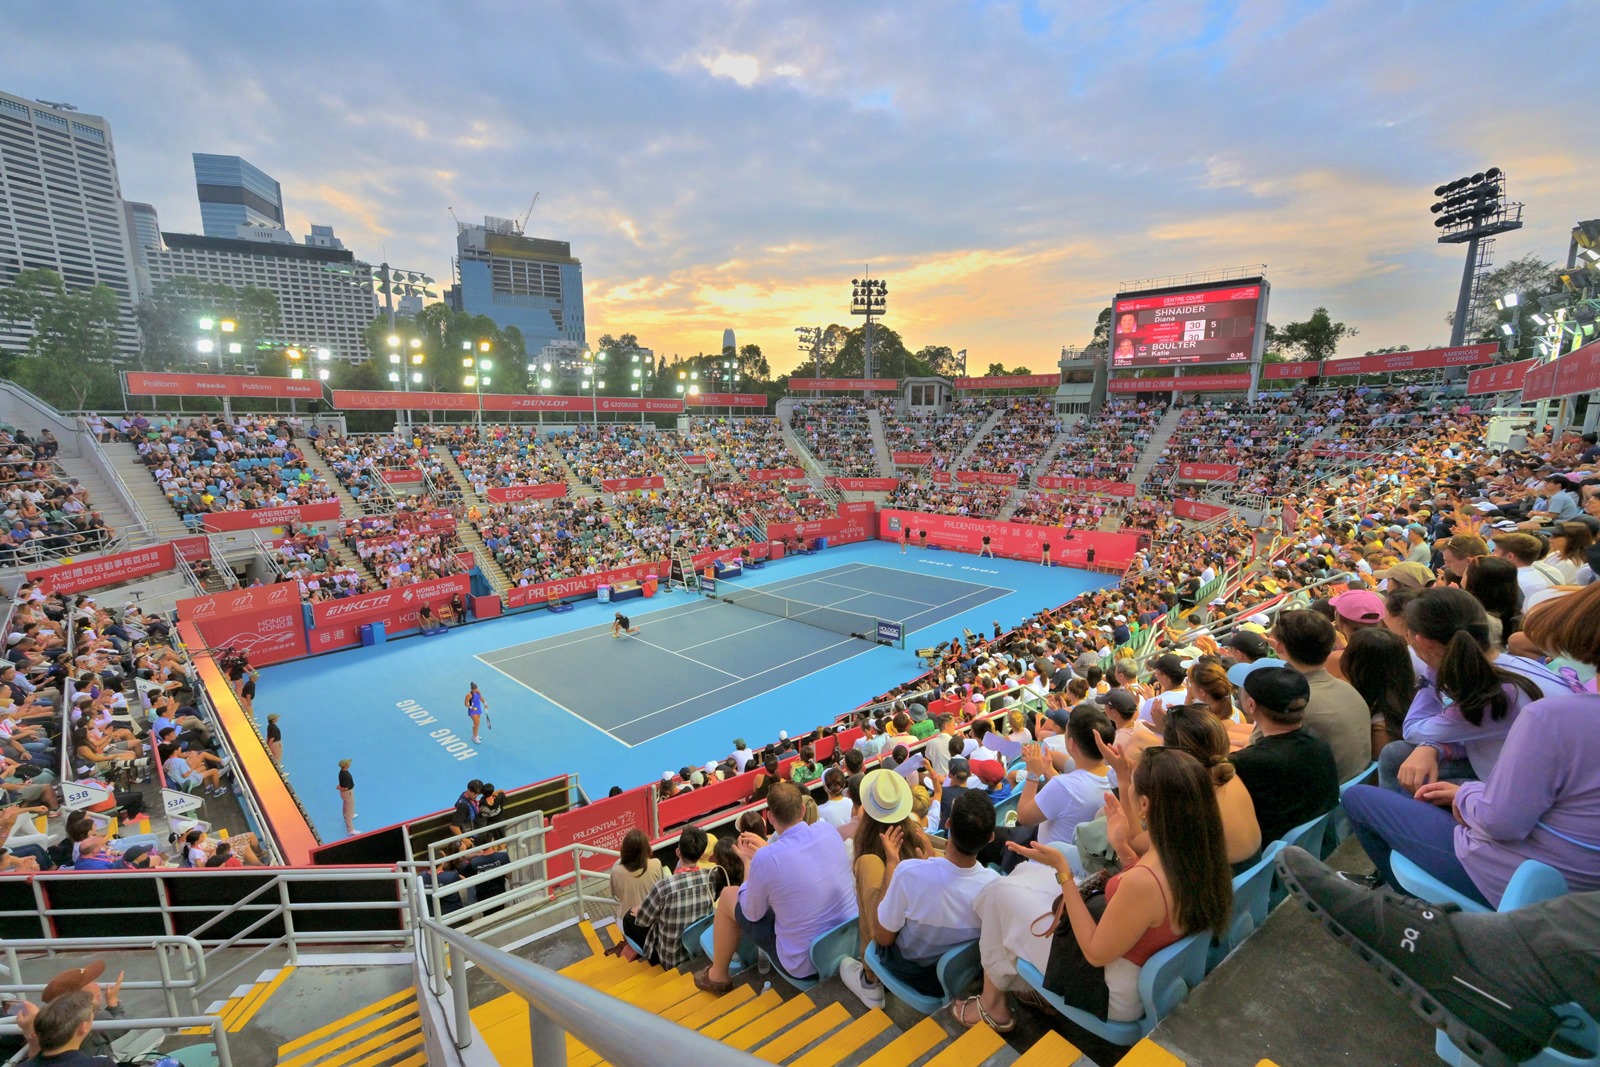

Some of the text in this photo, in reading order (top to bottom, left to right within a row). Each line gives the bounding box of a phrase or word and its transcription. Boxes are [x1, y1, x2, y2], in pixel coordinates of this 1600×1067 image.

[1155, 306, 1206, 316] SHNAIDER
[1152, 342, 1196, 350] BOULTER
[1443, 349, 1478, 357] AMERICAN
[352, 395, 465, 406] LALIQUE LALIQUE
[506, 490, 524, 499] EFG
[252, 508, 300, 518] AMERICAN
[944, 521, 985, 532] PRUDENTIAL
[50, 552, 158, 583] 大型體育活動事務委員會
[961, 566, 999, 574] HONG
[52, 562, 160, 591] Major Sports Events Committee
[416, 585, 436, 594] HONG
[416, 585, 464, 600] TENNIS SERIES
[529, 580, 589, 599] PRUDENTIAL
[338, 595, 392, 612] HKCTA
[258, 617, 285, 626] HONG
[258, 623, 286, 632] KONG
[320, 630, 345, 644] 香港
[396, 699, 478, 761] HONG KONG
[69, 791, 88, 802] S3B
[168, 798, 185, 808] S3A
[572, 819, 618, 840] PRUDENTIAL
[593, 832, 615, 845] HONG
[616, 825, 636, 836] KONG
